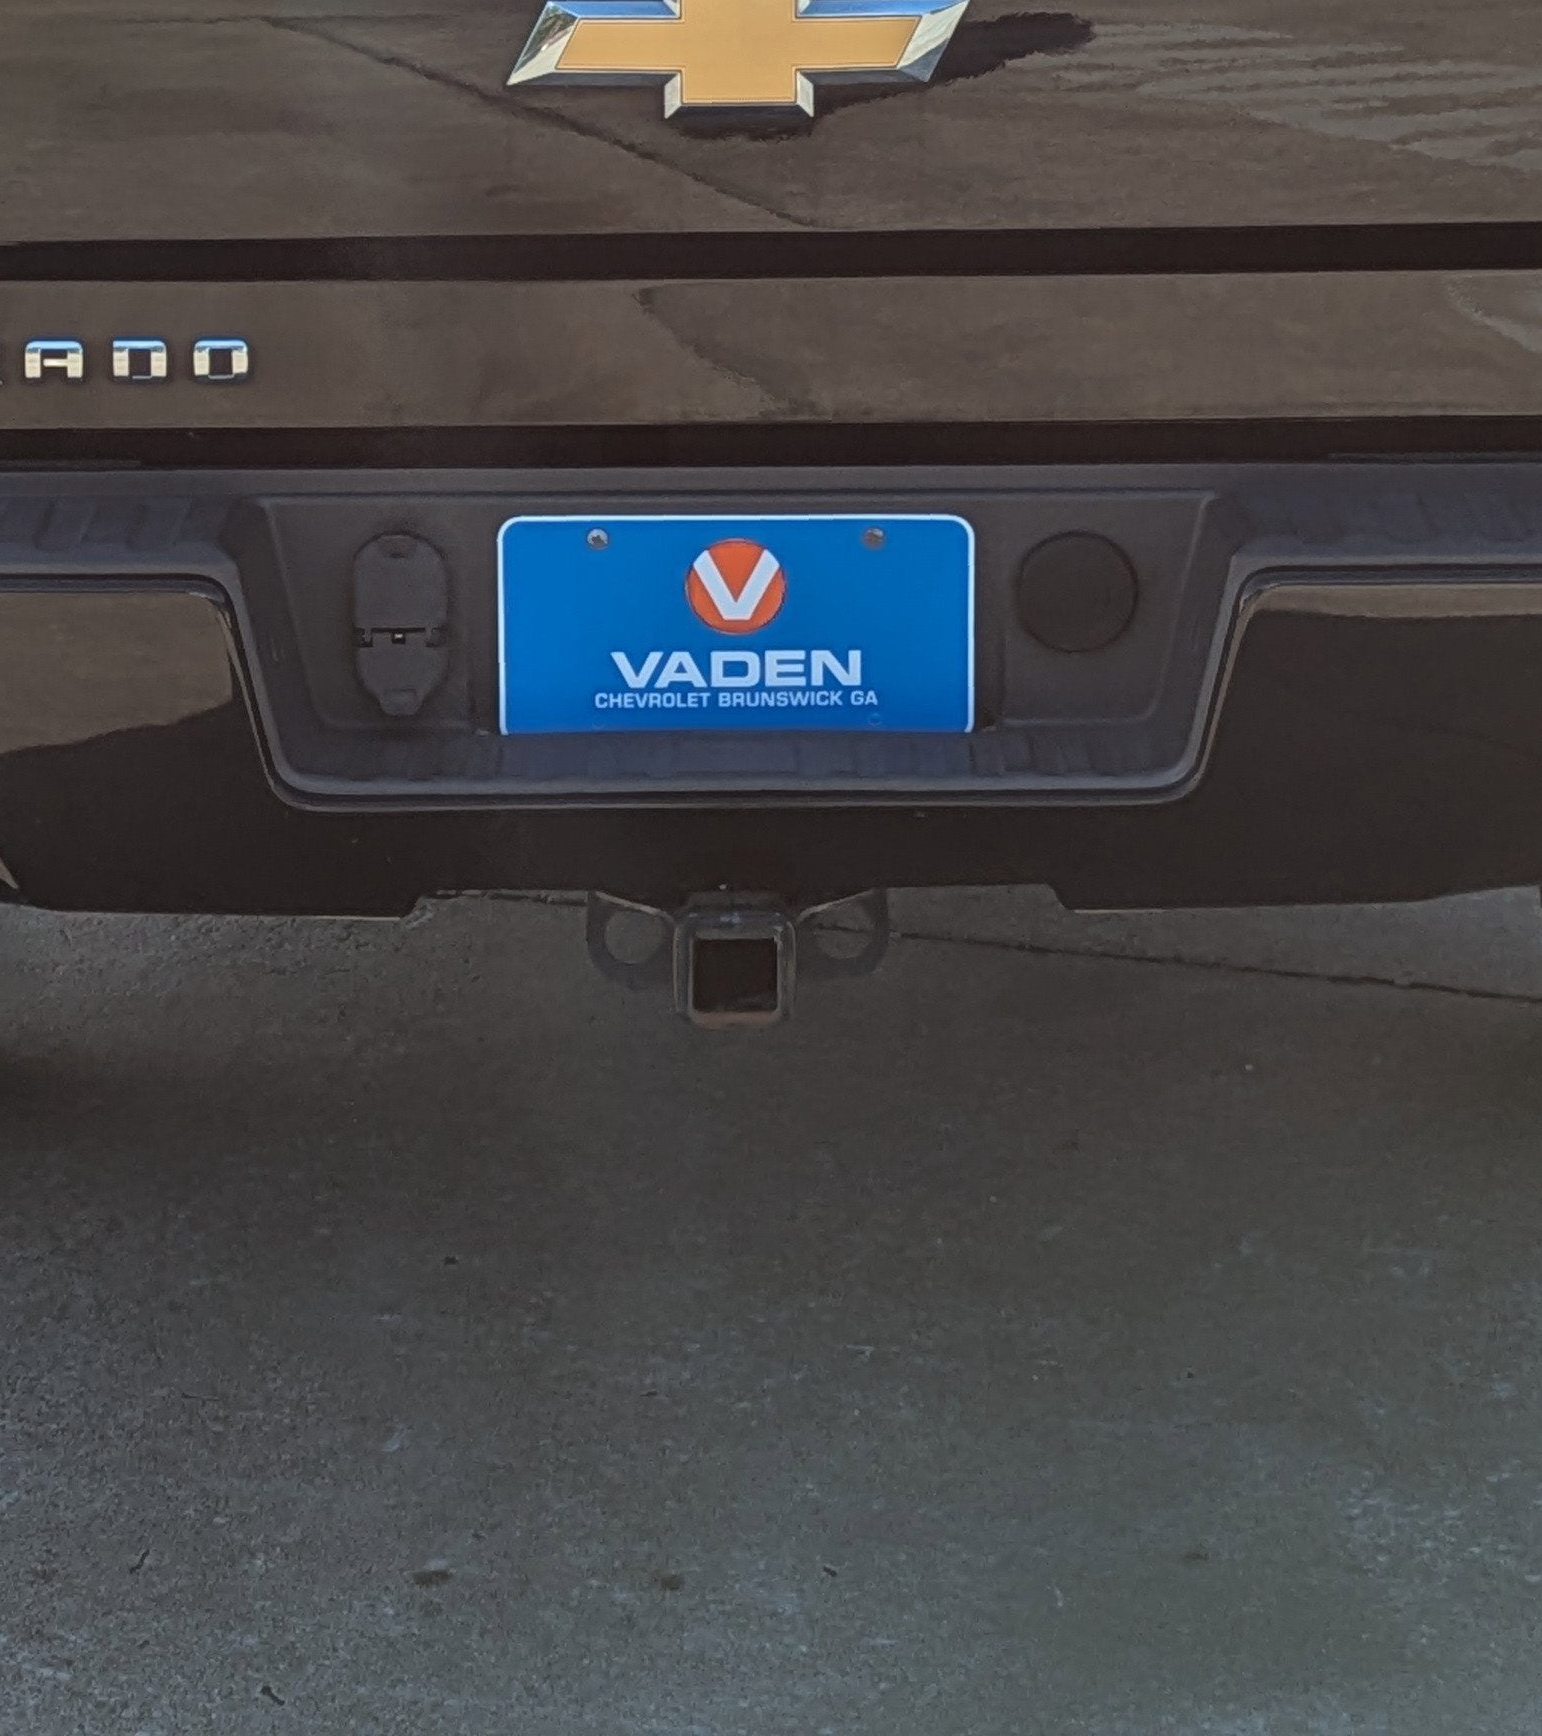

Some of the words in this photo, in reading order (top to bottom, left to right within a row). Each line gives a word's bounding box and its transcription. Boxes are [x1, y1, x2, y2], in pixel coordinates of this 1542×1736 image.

[692, 549, 781, 621] V
[610, 649, 863, 689] VADEN
[594, 691, 710, 709] CHEVROLET
[717, 690, 843, 708] BRUNSWICK
[849, 690, 878, 706] GA
